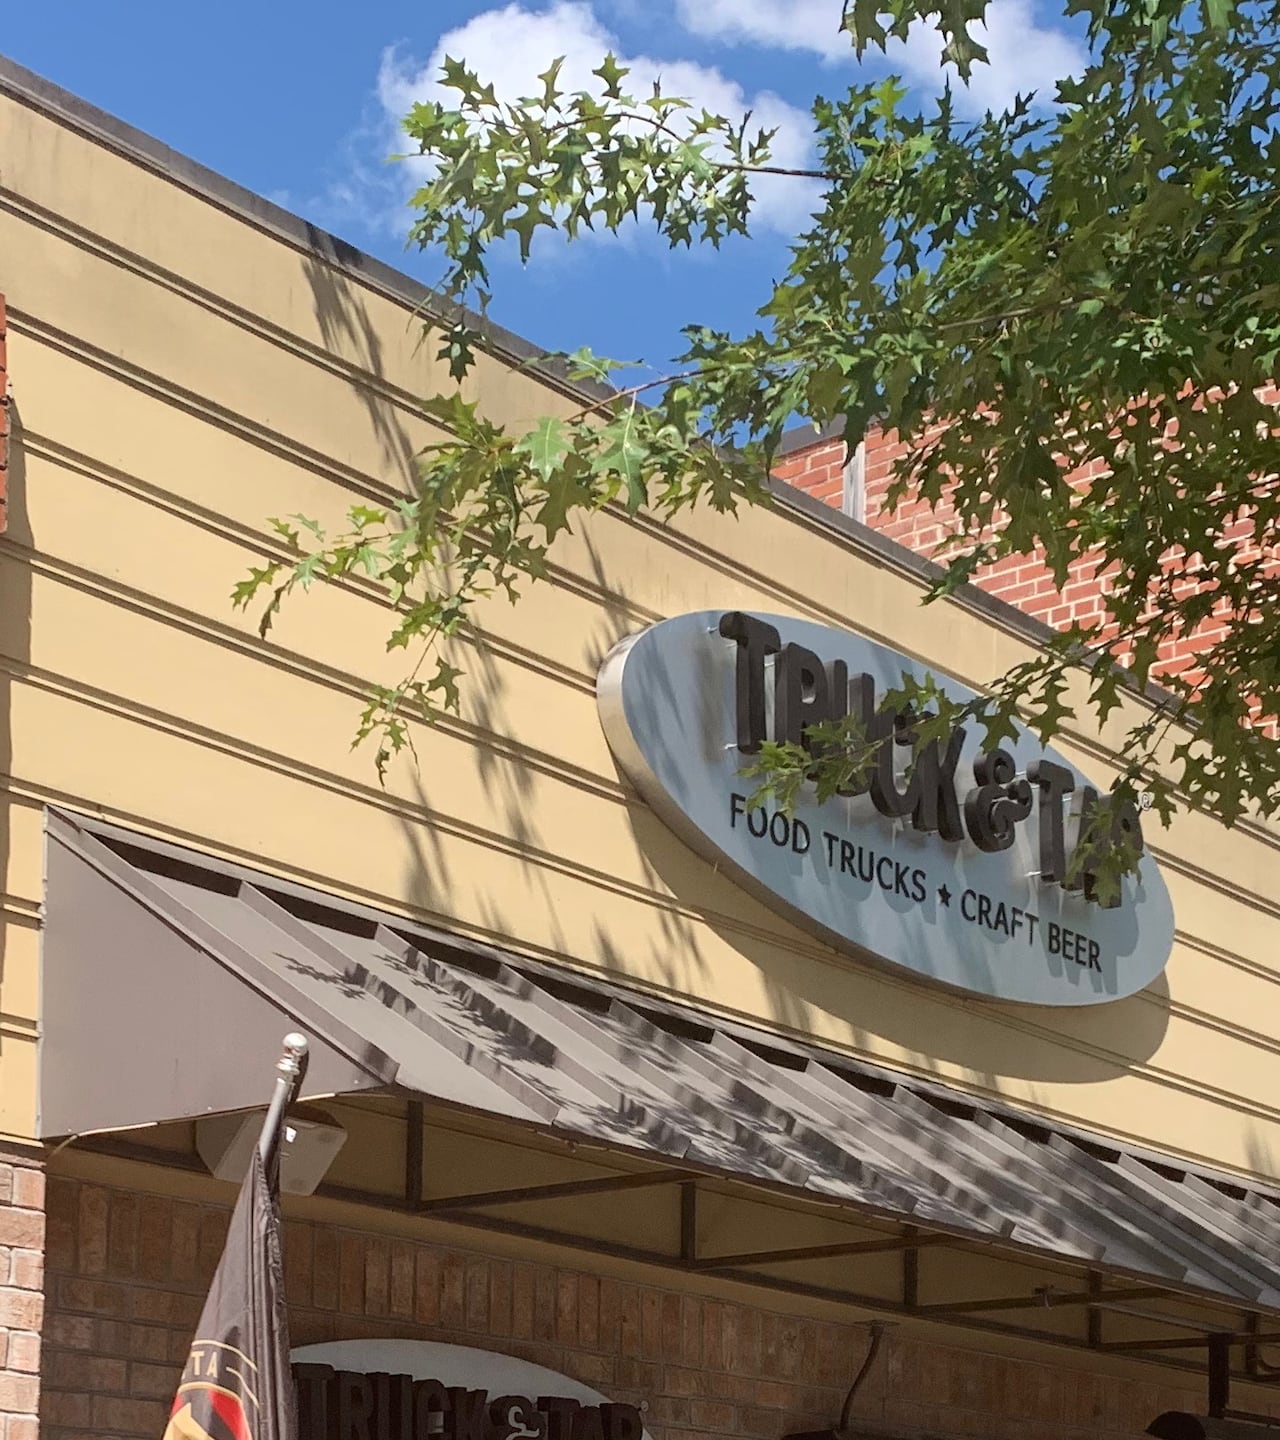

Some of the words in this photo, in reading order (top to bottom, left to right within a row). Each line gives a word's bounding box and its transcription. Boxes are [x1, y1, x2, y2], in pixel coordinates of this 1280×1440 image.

[730, 793, 811, 854] FOOD
[823, 831, 926, 902] TRUCKS
[961, 889, 1039, 946] CRAFT
[1048, 921, 1102, 973] BEER
